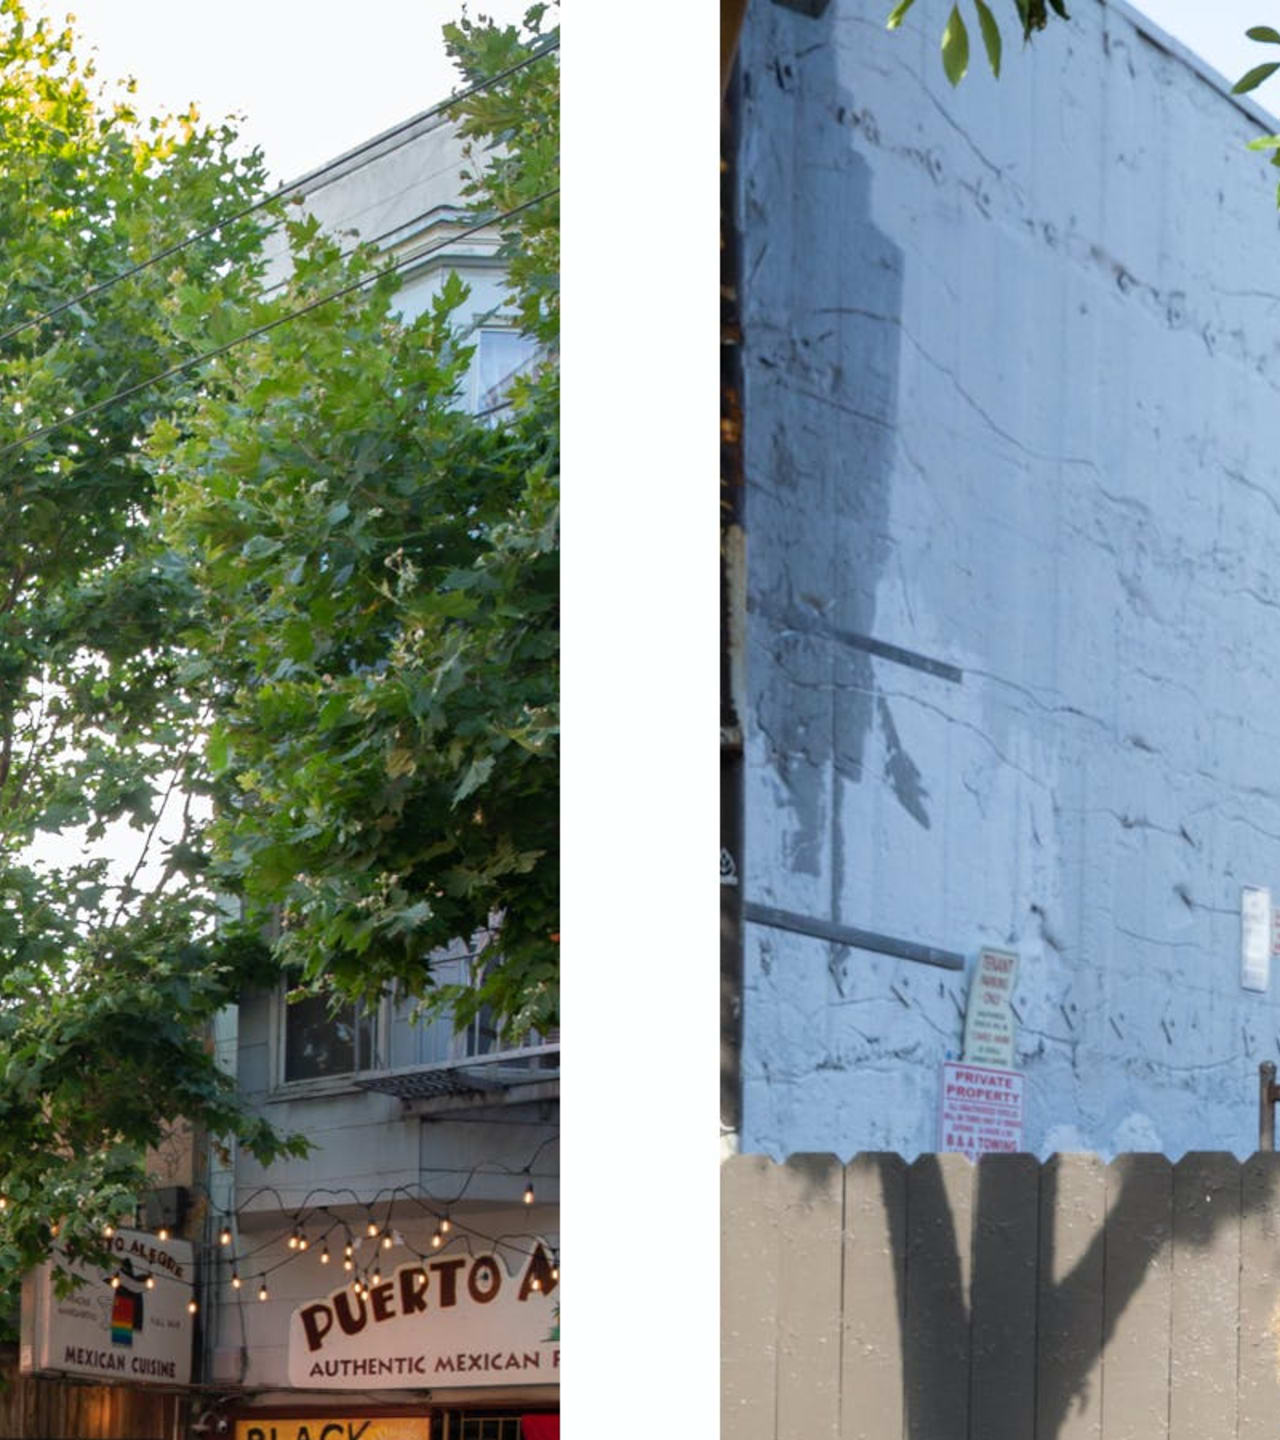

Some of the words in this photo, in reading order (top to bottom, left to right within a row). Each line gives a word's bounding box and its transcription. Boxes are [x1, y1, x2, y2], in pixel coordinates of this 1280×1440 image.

[946, 1083, 1020, 1104] PROPERTY
[955, 1071, 1013, 1089] PRIVATE
[131, 1239, 184, 1278] ALEGRE
[300, 1255, 501, 1352] PUERTO
[64, 1347, 126, 1371] MEXICAN
[131, 1357, 176, 1379] CUISINE
[310, 1356, 426, 1378] AUTHENTIC
[434, 1351, 540, 1373] MEXICAN
